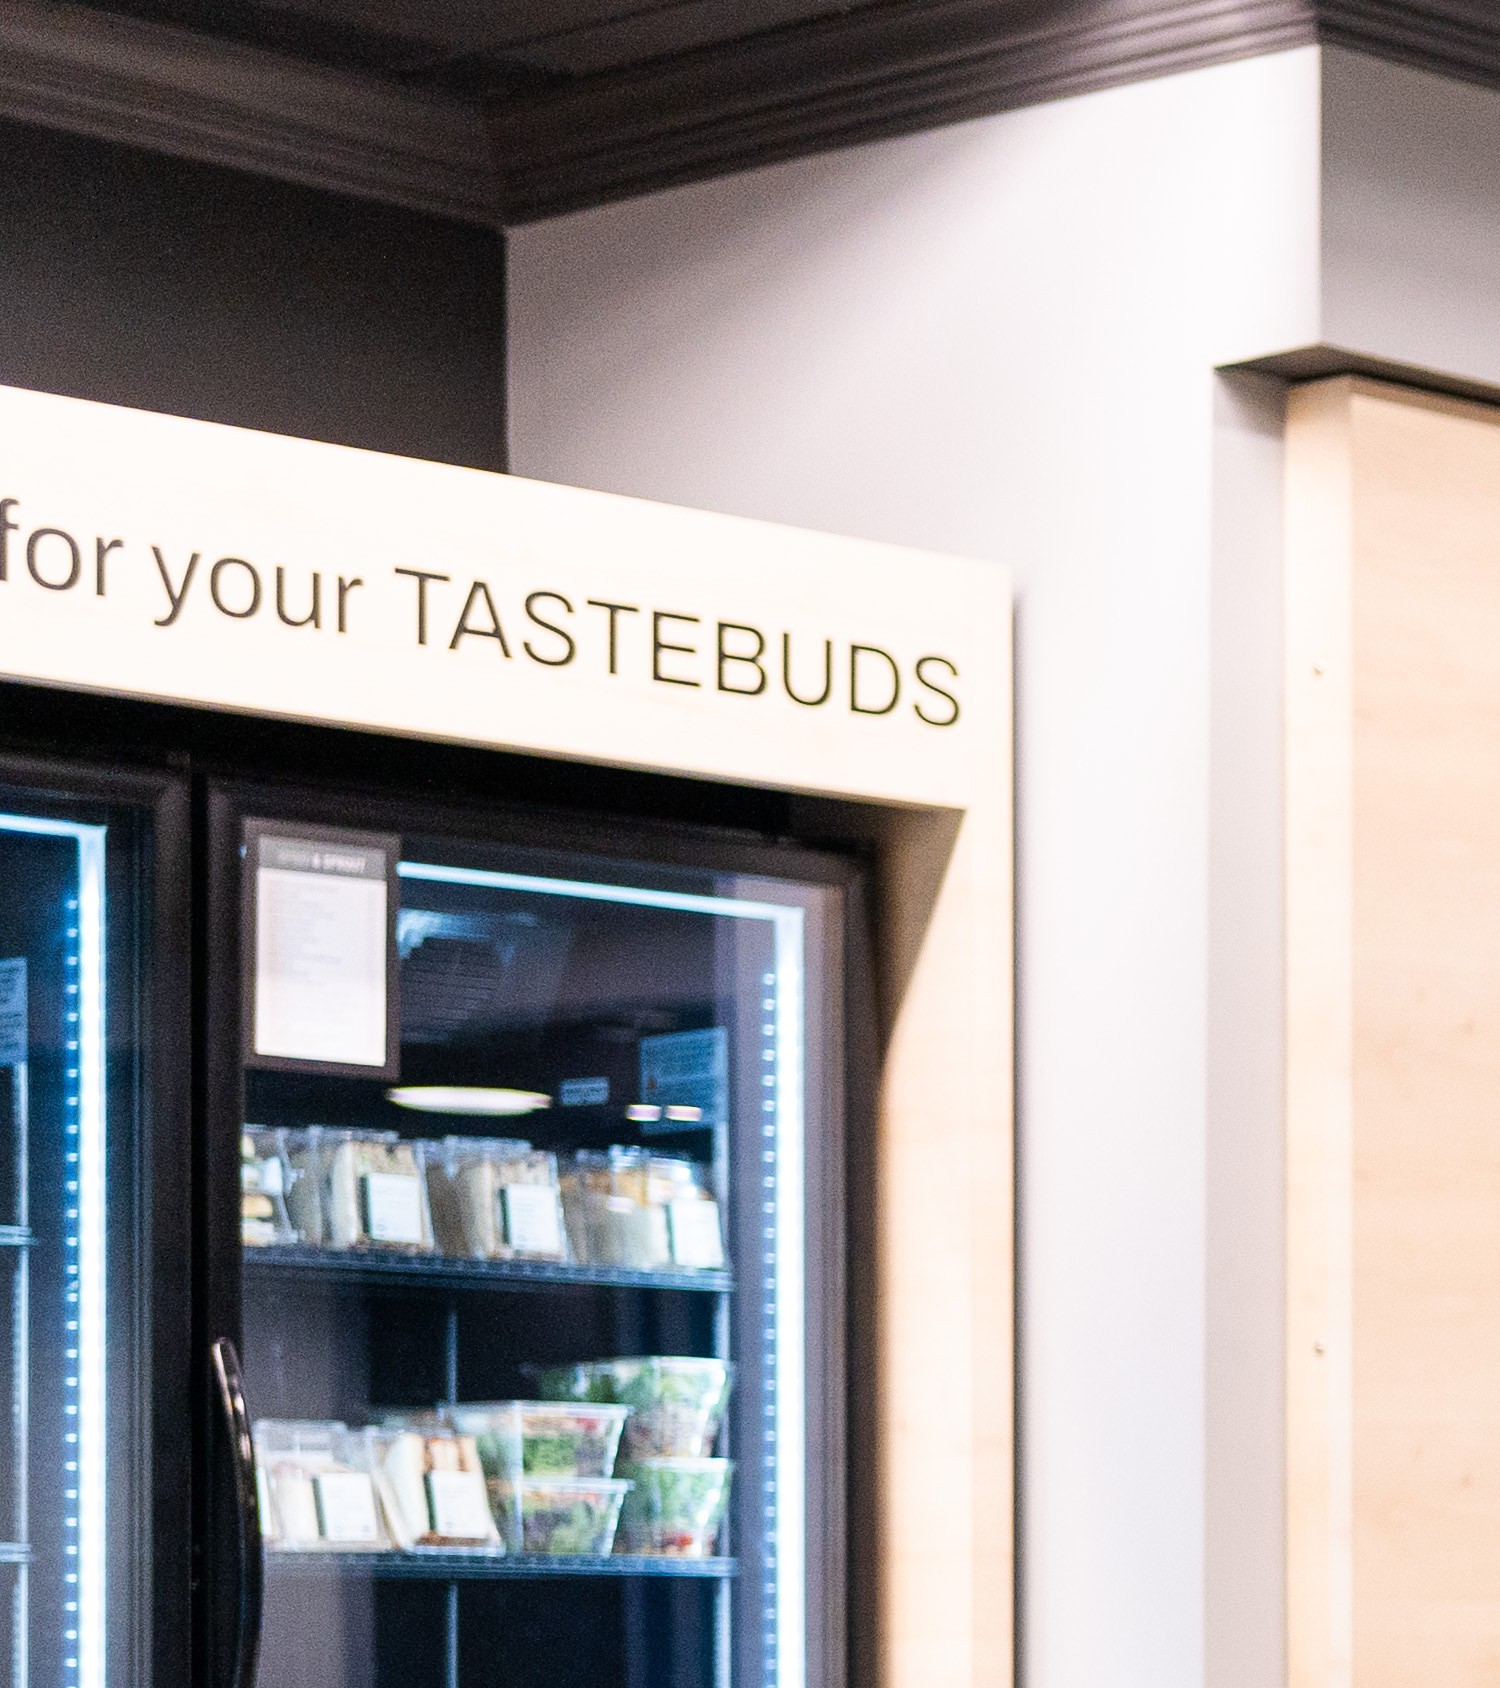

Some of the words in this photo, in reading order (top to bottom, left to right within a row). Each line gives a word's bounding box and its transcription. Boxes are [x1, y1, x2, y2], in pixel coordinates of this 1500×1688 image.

[0, 497, 124, 595] for
[151, 542, 364, 628] your
[394, 567, 962, 728] TASTEBUDS
